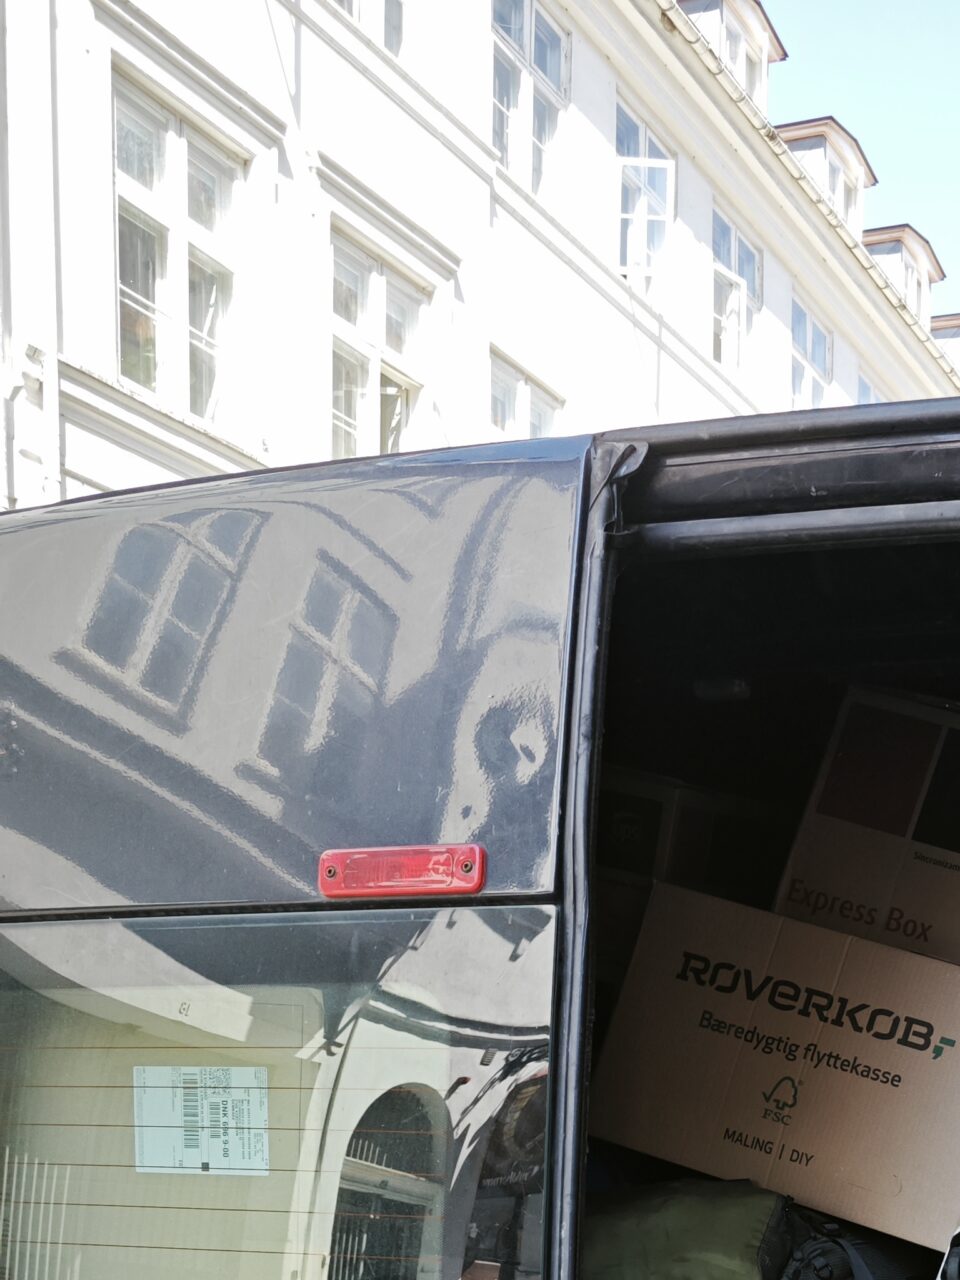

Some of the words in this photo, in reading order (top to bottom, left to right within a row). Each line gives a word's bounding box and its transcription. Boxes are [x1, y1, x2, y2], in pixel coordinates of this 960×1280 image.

[787, 878, 878, 926] Express
[885, 906, 933, 942] Box
[699, 1010, 800, 1060] Bæredygtig
[803, 1042, 902, 1088] flyttekasse
[761, 1109, 792, 1126] FSC
[723, 1127, 774, 1155] MALING
[789, 1148, 815, 1167] DIY
